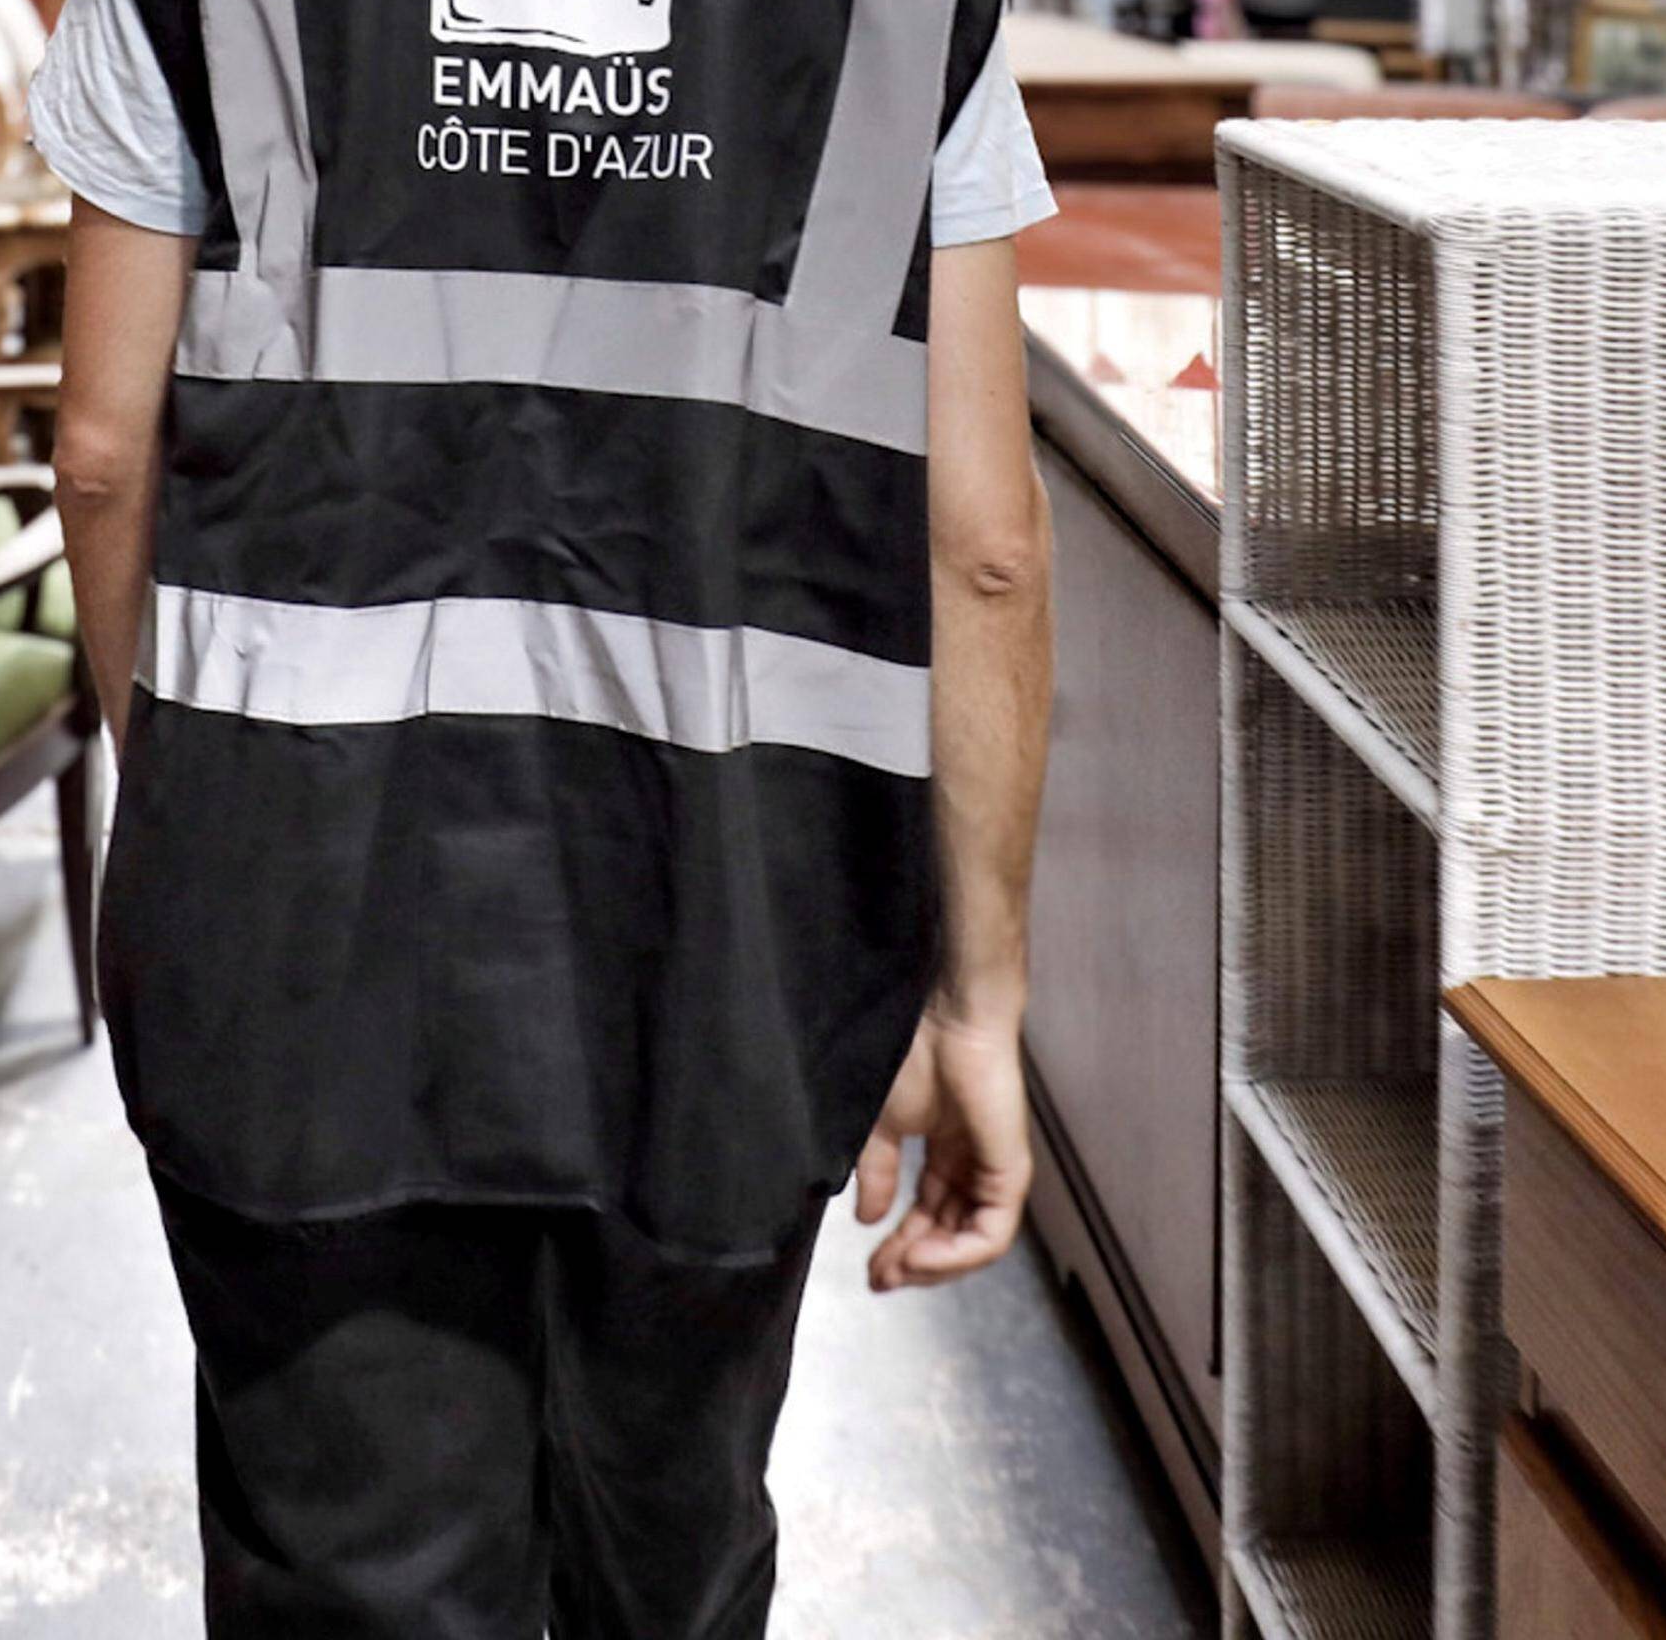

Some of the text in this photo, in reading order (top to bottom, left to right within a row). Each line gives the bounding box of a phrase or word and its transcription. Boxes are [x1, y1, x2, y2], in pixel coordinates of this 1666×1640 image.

[434, 56, 673, 116] EMMAÜS
[418, 116, 713, 180] CÔTE D'AZUR
